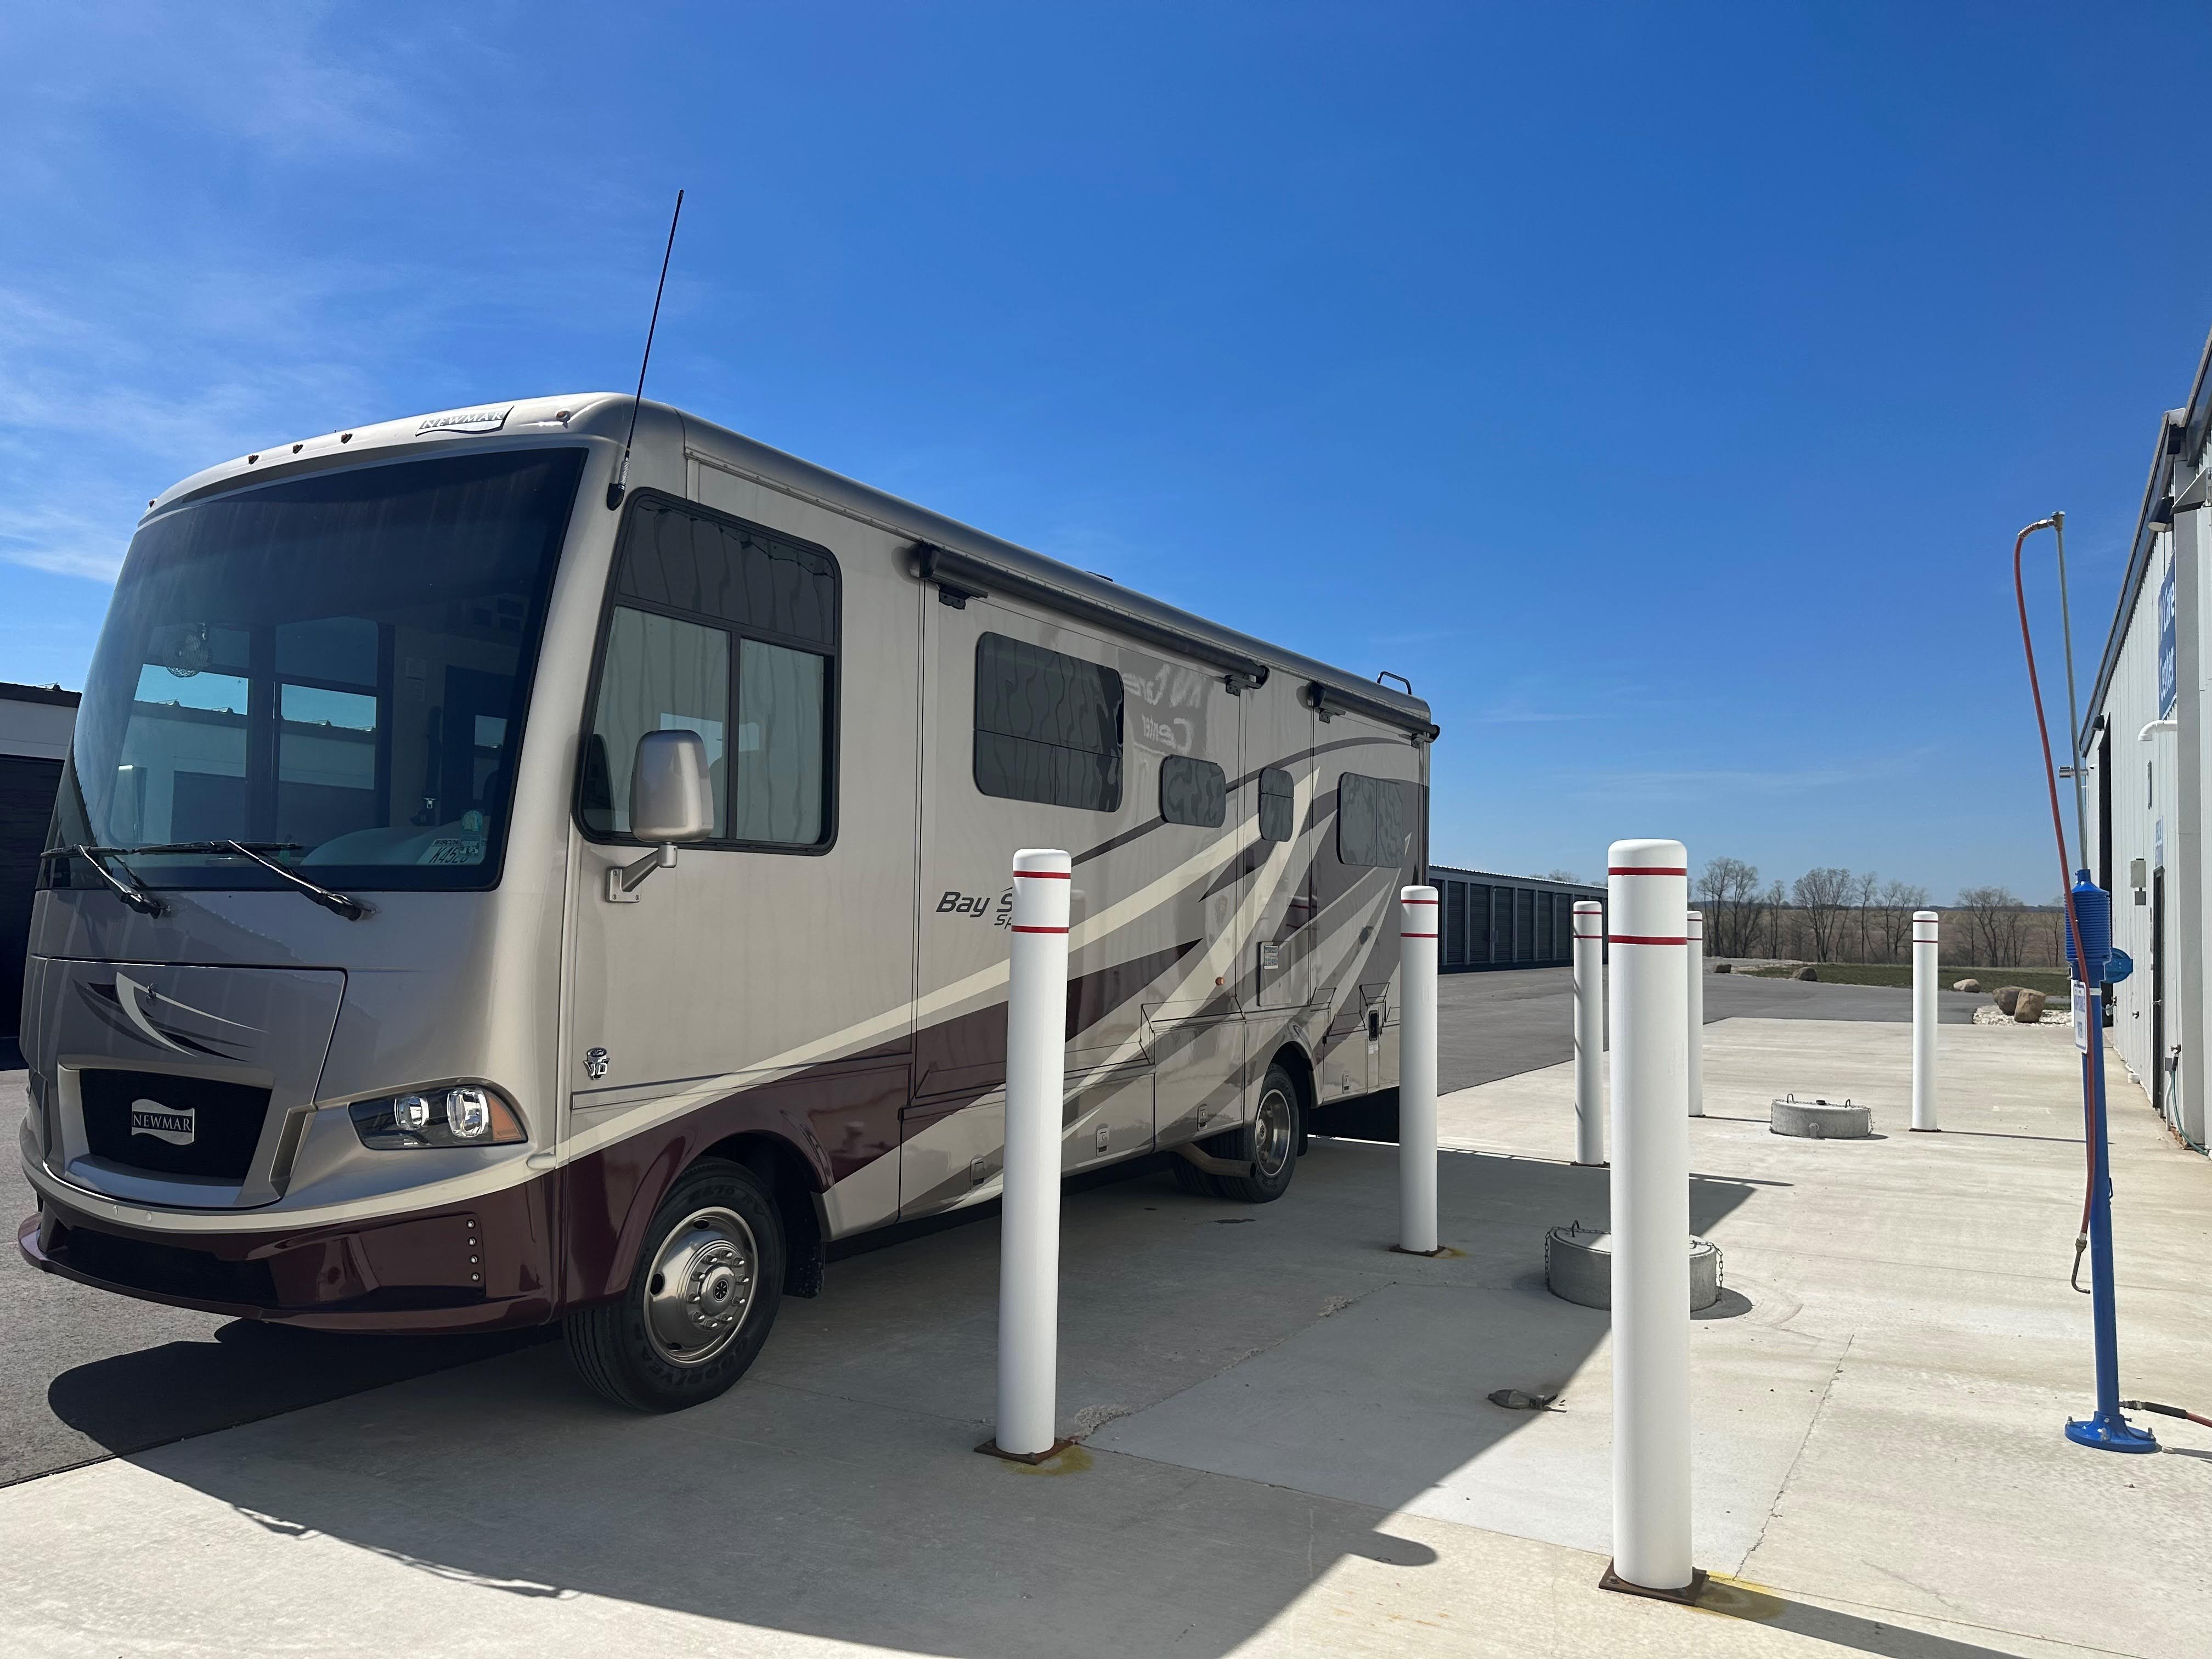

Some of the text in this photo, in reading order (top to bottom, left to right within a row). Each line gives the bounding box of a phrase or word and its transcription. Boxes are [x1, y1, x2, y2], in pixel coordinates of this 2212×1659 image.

[422, 411, 504, 429] NEWMAR
[2164, 581, 2175, 633] Care
[2159, 645, 2174, 702] Center
[936, 891, 990, 918] Bay
[133, 1114, 191, 1132] NEWMAR
